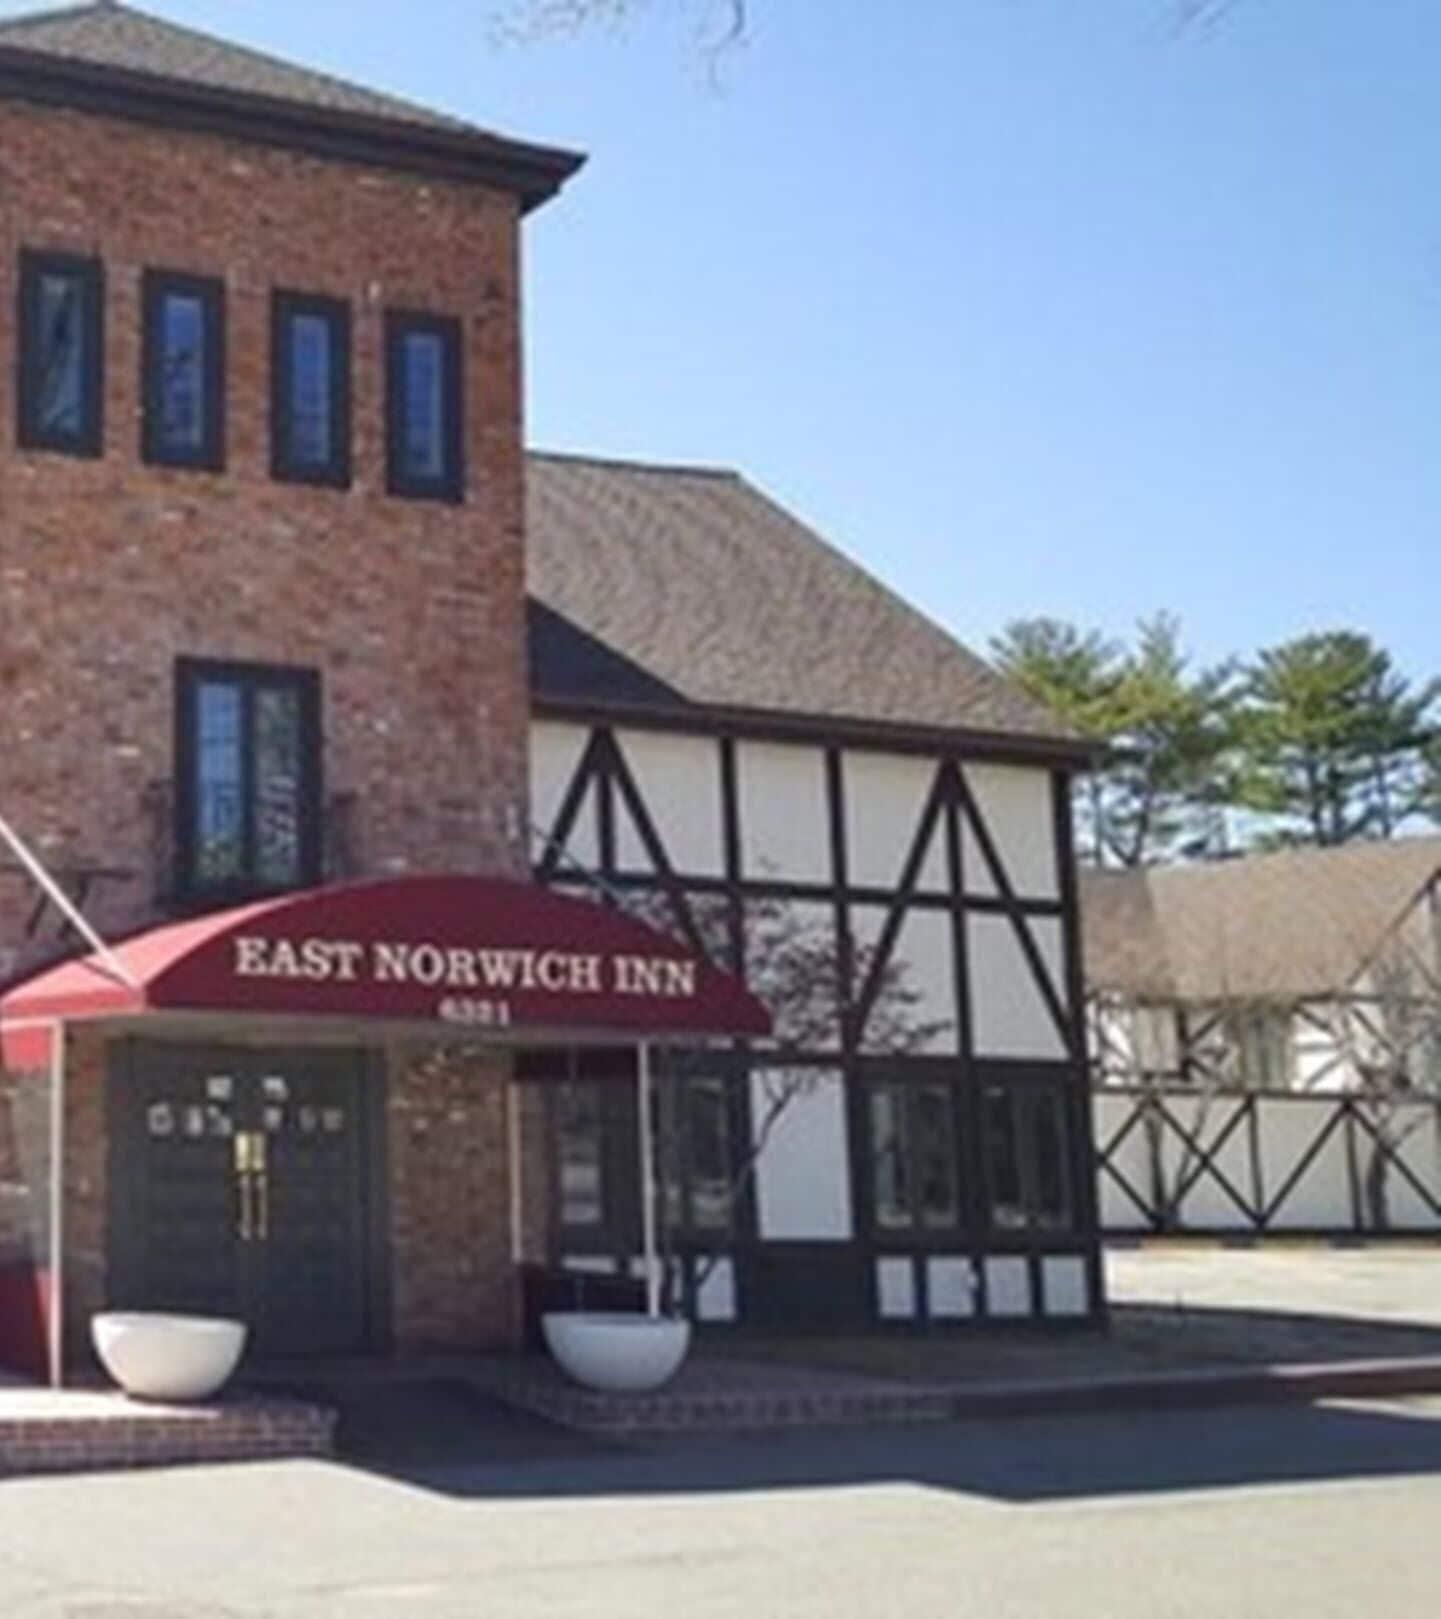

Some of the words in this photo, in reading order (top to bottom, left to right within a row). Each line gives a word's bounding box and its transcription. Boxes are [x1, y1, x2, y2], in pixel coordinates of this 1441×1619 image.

[234, 936, 363, 980] EAST
[373, 945, 602, 992] NORWICH
[614, 956, 697, 997] INN
